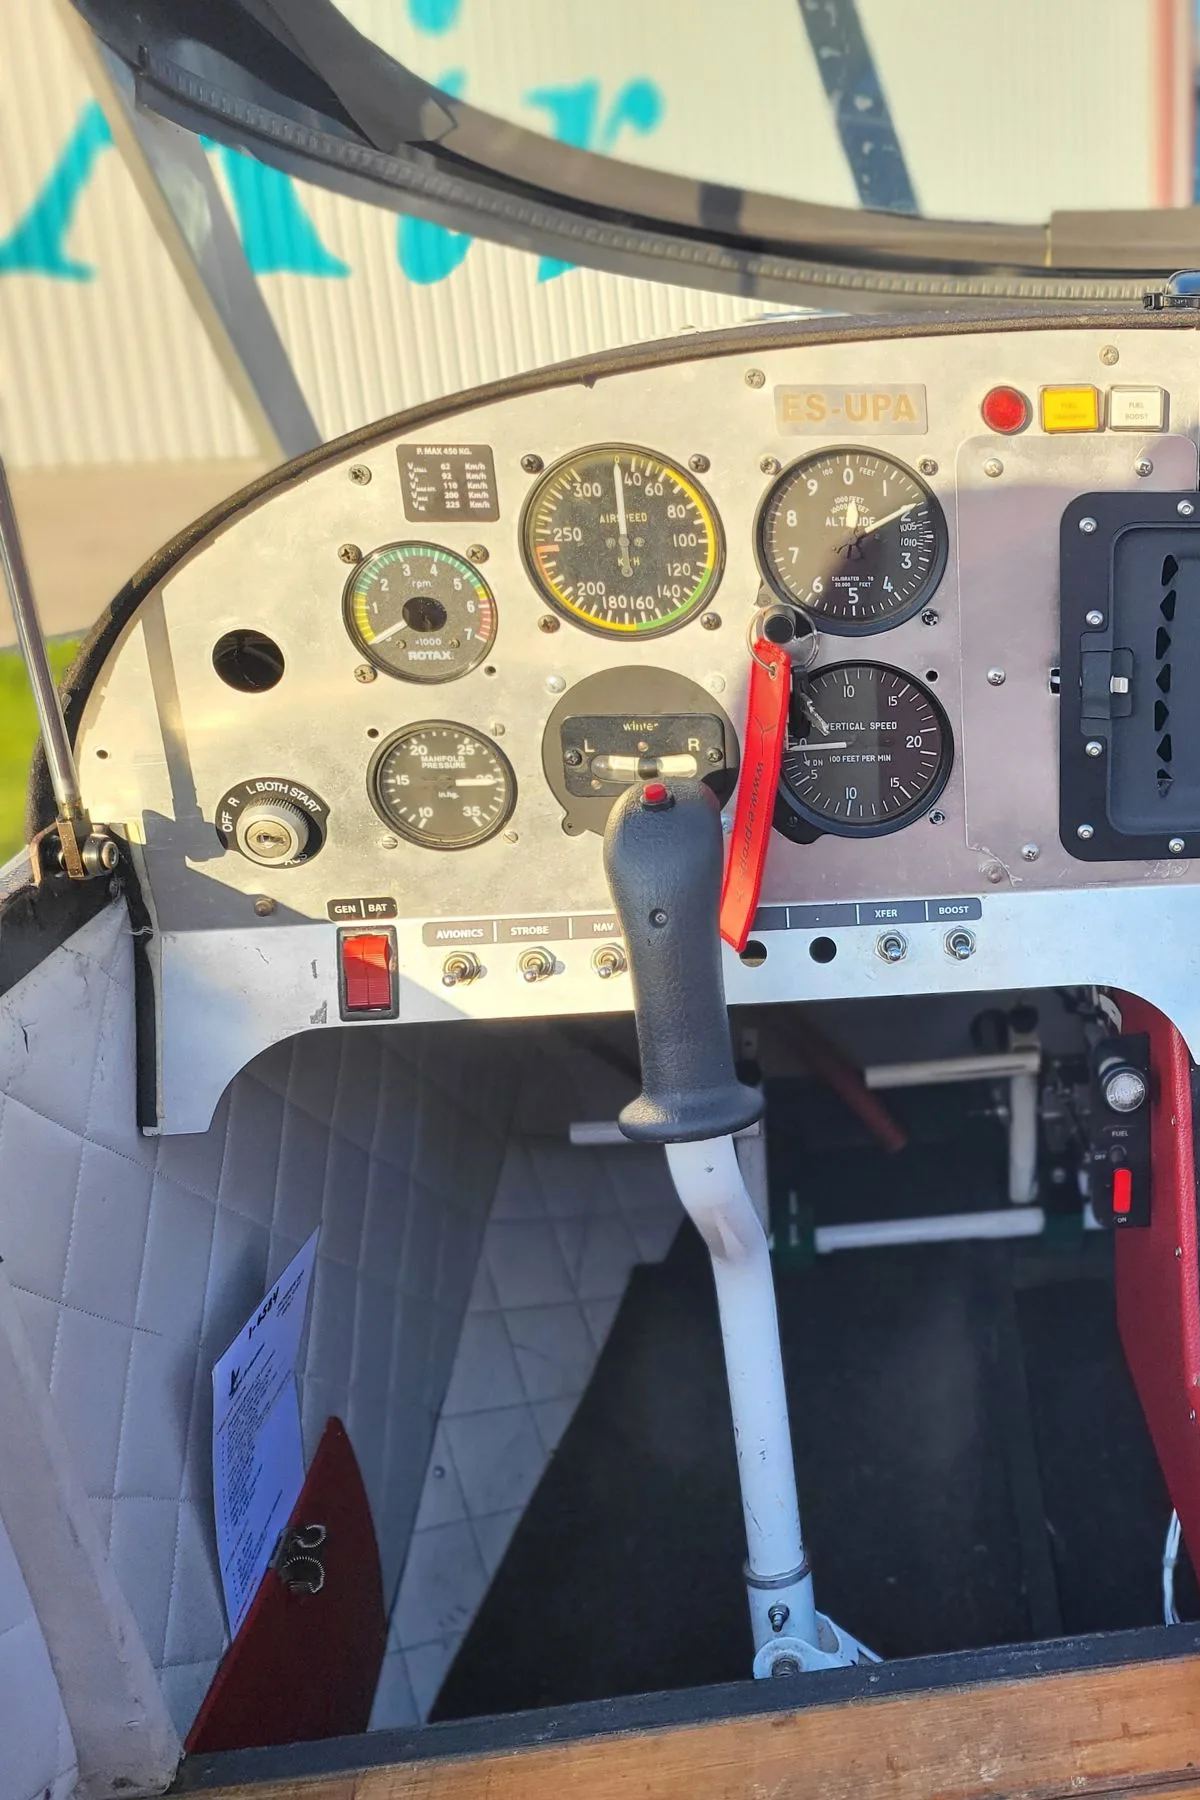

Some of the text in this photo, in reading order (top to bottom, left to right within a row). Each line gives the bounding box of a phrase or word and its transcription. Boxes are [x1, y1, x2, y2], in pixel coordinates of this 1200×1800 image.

[782, 393, 915, 421] ES-UPA
[624, 473, 642, 485] 40
[843, 468, 853, 485] 0
[573, 484, 601, 497] 300
[645, 484, 663, 496] 60
[807, 480, 817, 495] 9
[667, 505, 685, 518] 80
[786, 511, 797, 526] 8
[554, 528, 582, 541] 250
[673, 535, 696, 546] 100
[789, 548, 799, 563] 7
[901, 553, 912, 569] 3
[402, 564, 411, 576] 3
[430, 564, 437, 576] 4
[667, 563, 690, 576] 120
[380, 579, 389, 591] 2
[412, 580, 431, 588] rpm
[453, 579, 462, 590] 5
[578, 583, 605, 596] 200
[813, 577, 823, 593] 6
[883, 577, 893, 592] 4
[657, 585, 680, 598] 140
[849, 589, 858, 603] 5
[372, 603, 378, 613] 1
[467, 601, 474, 612] 6
[603, 596, 626, 609] 180
[631, 596, 654, 609] 160
[464, 628, 472, 640] 7
[408, 651, 451, 660] ROTAX
[844, 686, 854, 698] 10
[888, 696, 897, 706] 15
[584, 740, 594, 752] L
[688, 738, 699, 751] R
[906, 736, 922, 747] 20
[410, 745, 427, 755] 20
[457, 745, 475, 755] 25
[396, 775, 410, 785] 15
[811, 770, 817, 779] 5
[256, 782, 288, 793] BOTH
[891, 778, 900, 787] 15
[246, 786, 256, 794] L
[846, 788, 857, 798] 10
[228, 797, 240, 807] R
[290, 788, 321, 812] START
[419, 807, 433, 817] 10
[463, 806, 480, 816] 35
[222, 811, 233, 832] OFF
[368, 904, 387, 912] BAT
[875, 910, 897, 918] XFER
[939, 906, 969, 914] BOOST
[511, 926, 549, 935] STROBE
[593, 923, 614, 932] NAV
[436, 929, 483, 939] AVIONICS
